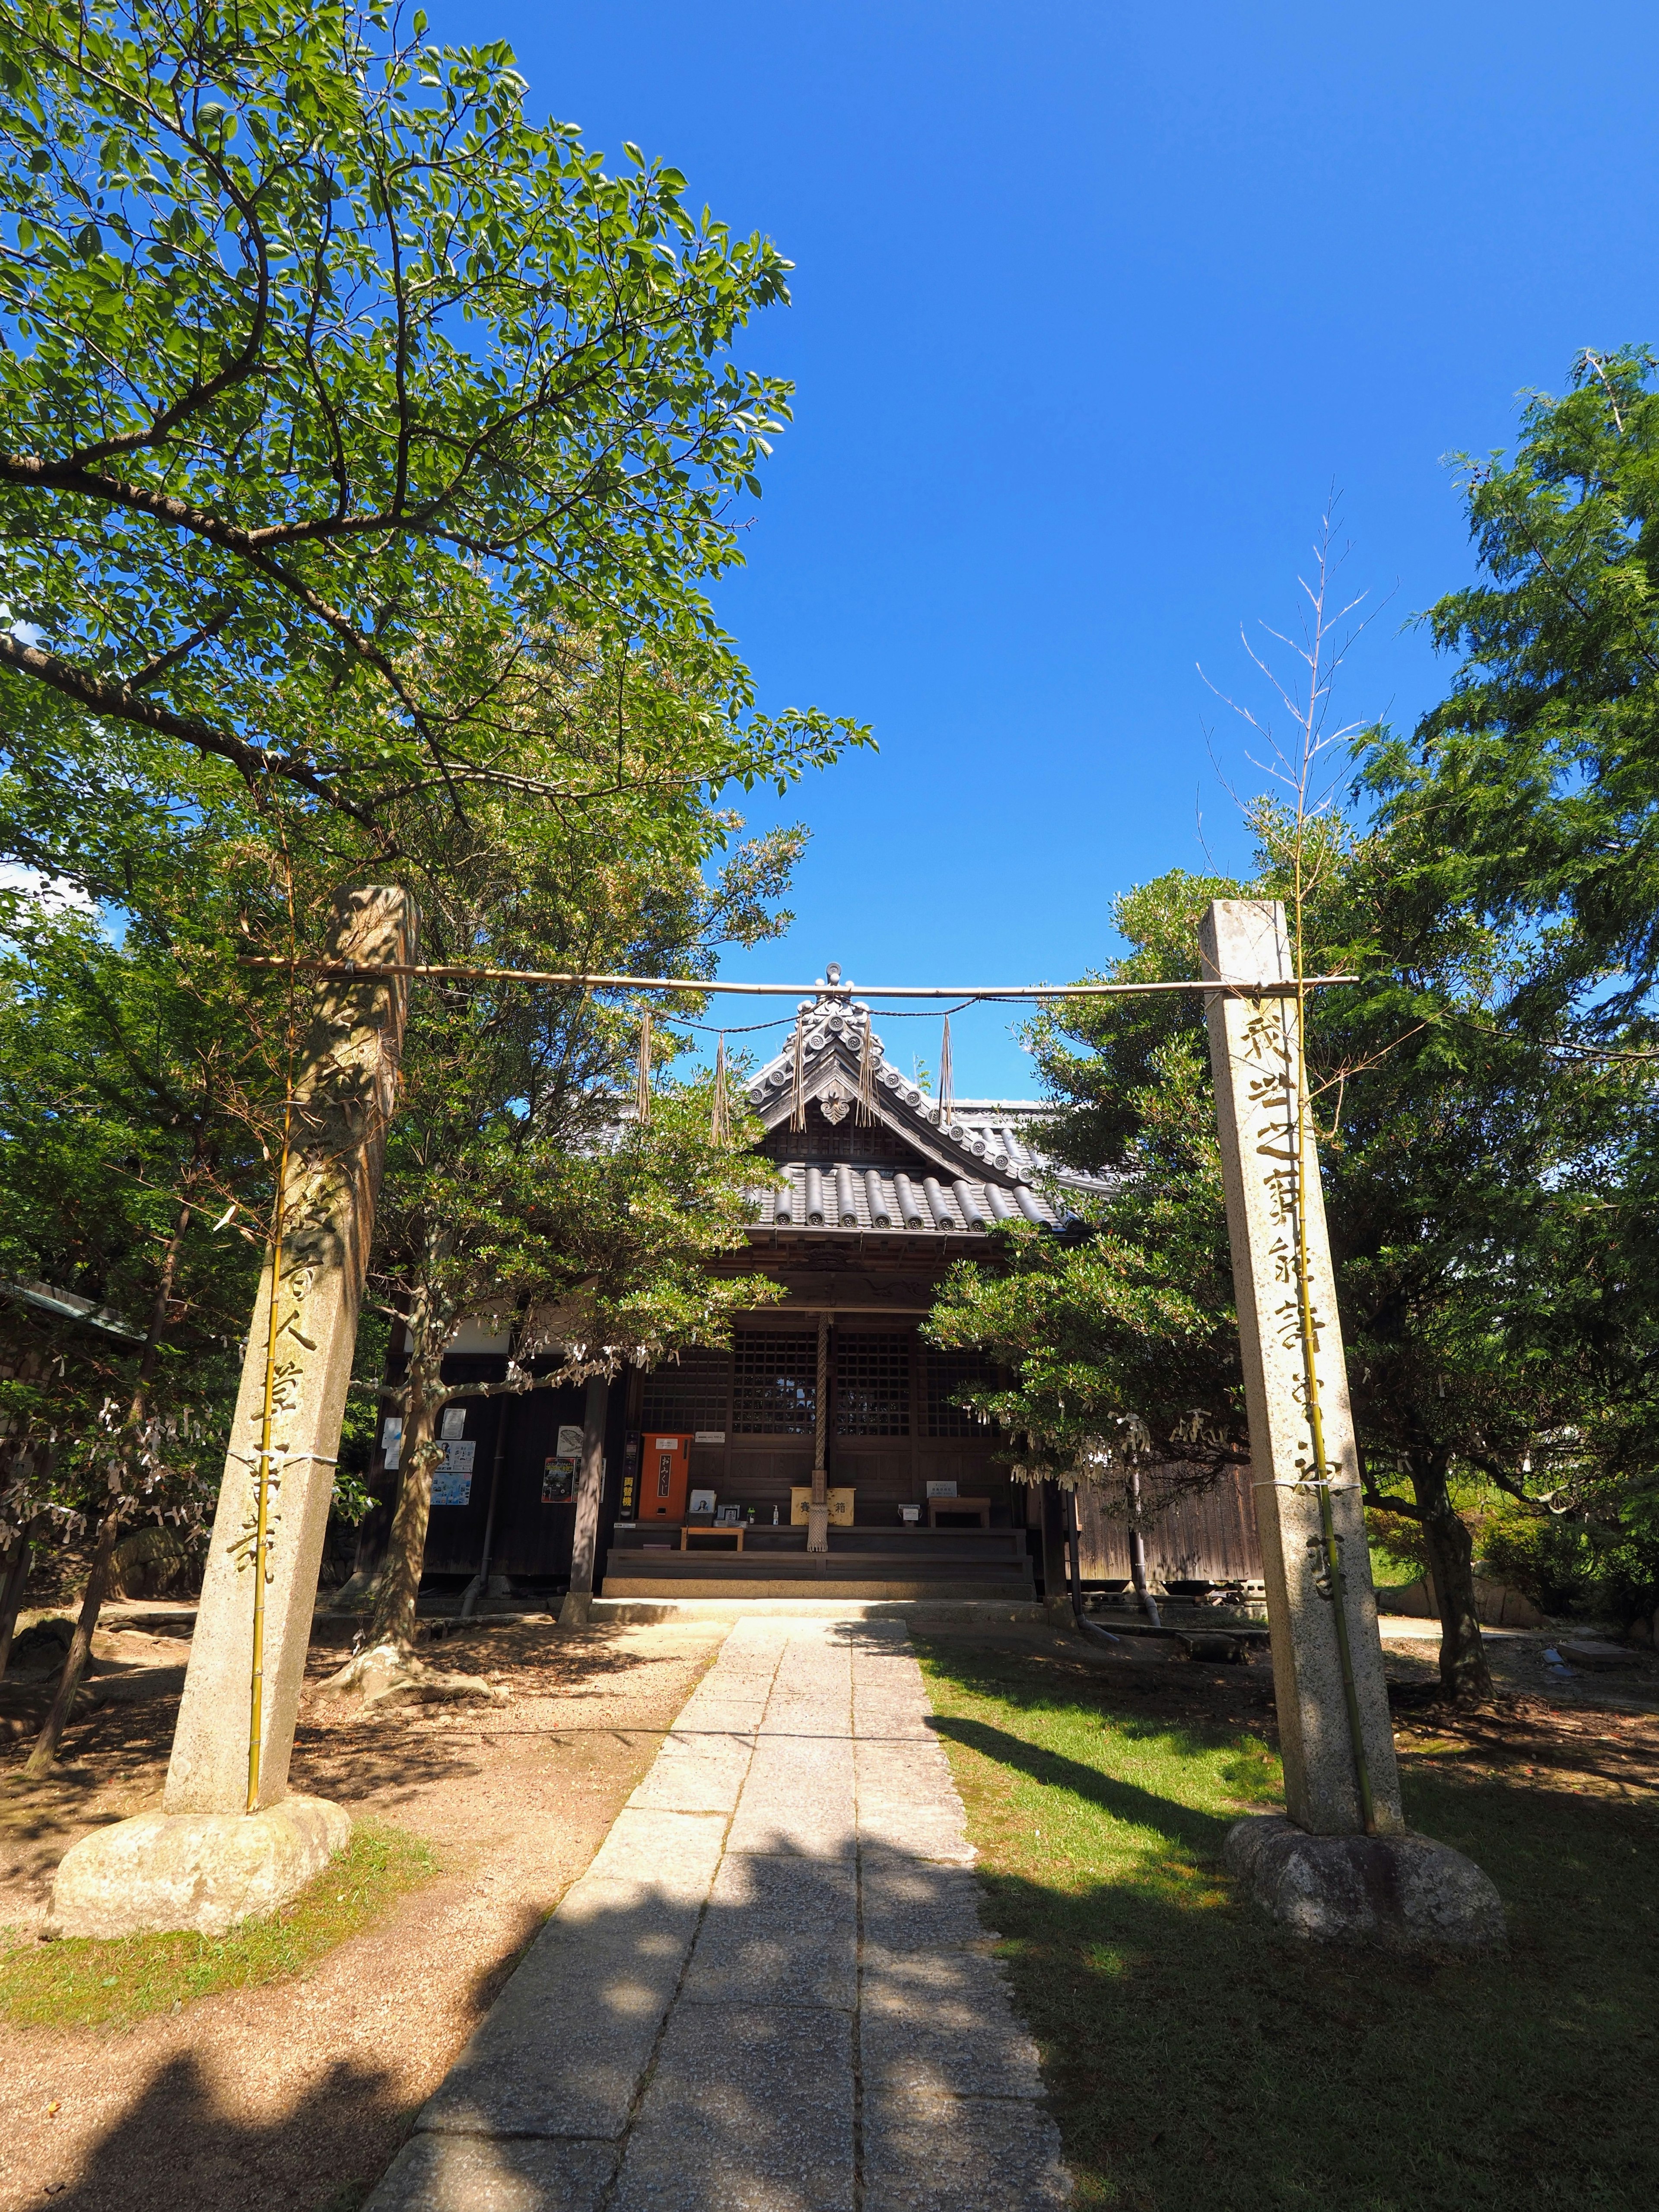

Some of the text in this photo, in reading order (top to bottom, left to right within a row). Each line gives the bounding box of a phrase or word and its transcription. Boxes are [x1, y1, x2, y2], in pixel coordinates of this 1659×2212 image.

[661, 1456, 670, 1496] おみくじ
[622, 1477, 634, 1506] 両替機
[801, 1501, 845, 1513] 賽箱
